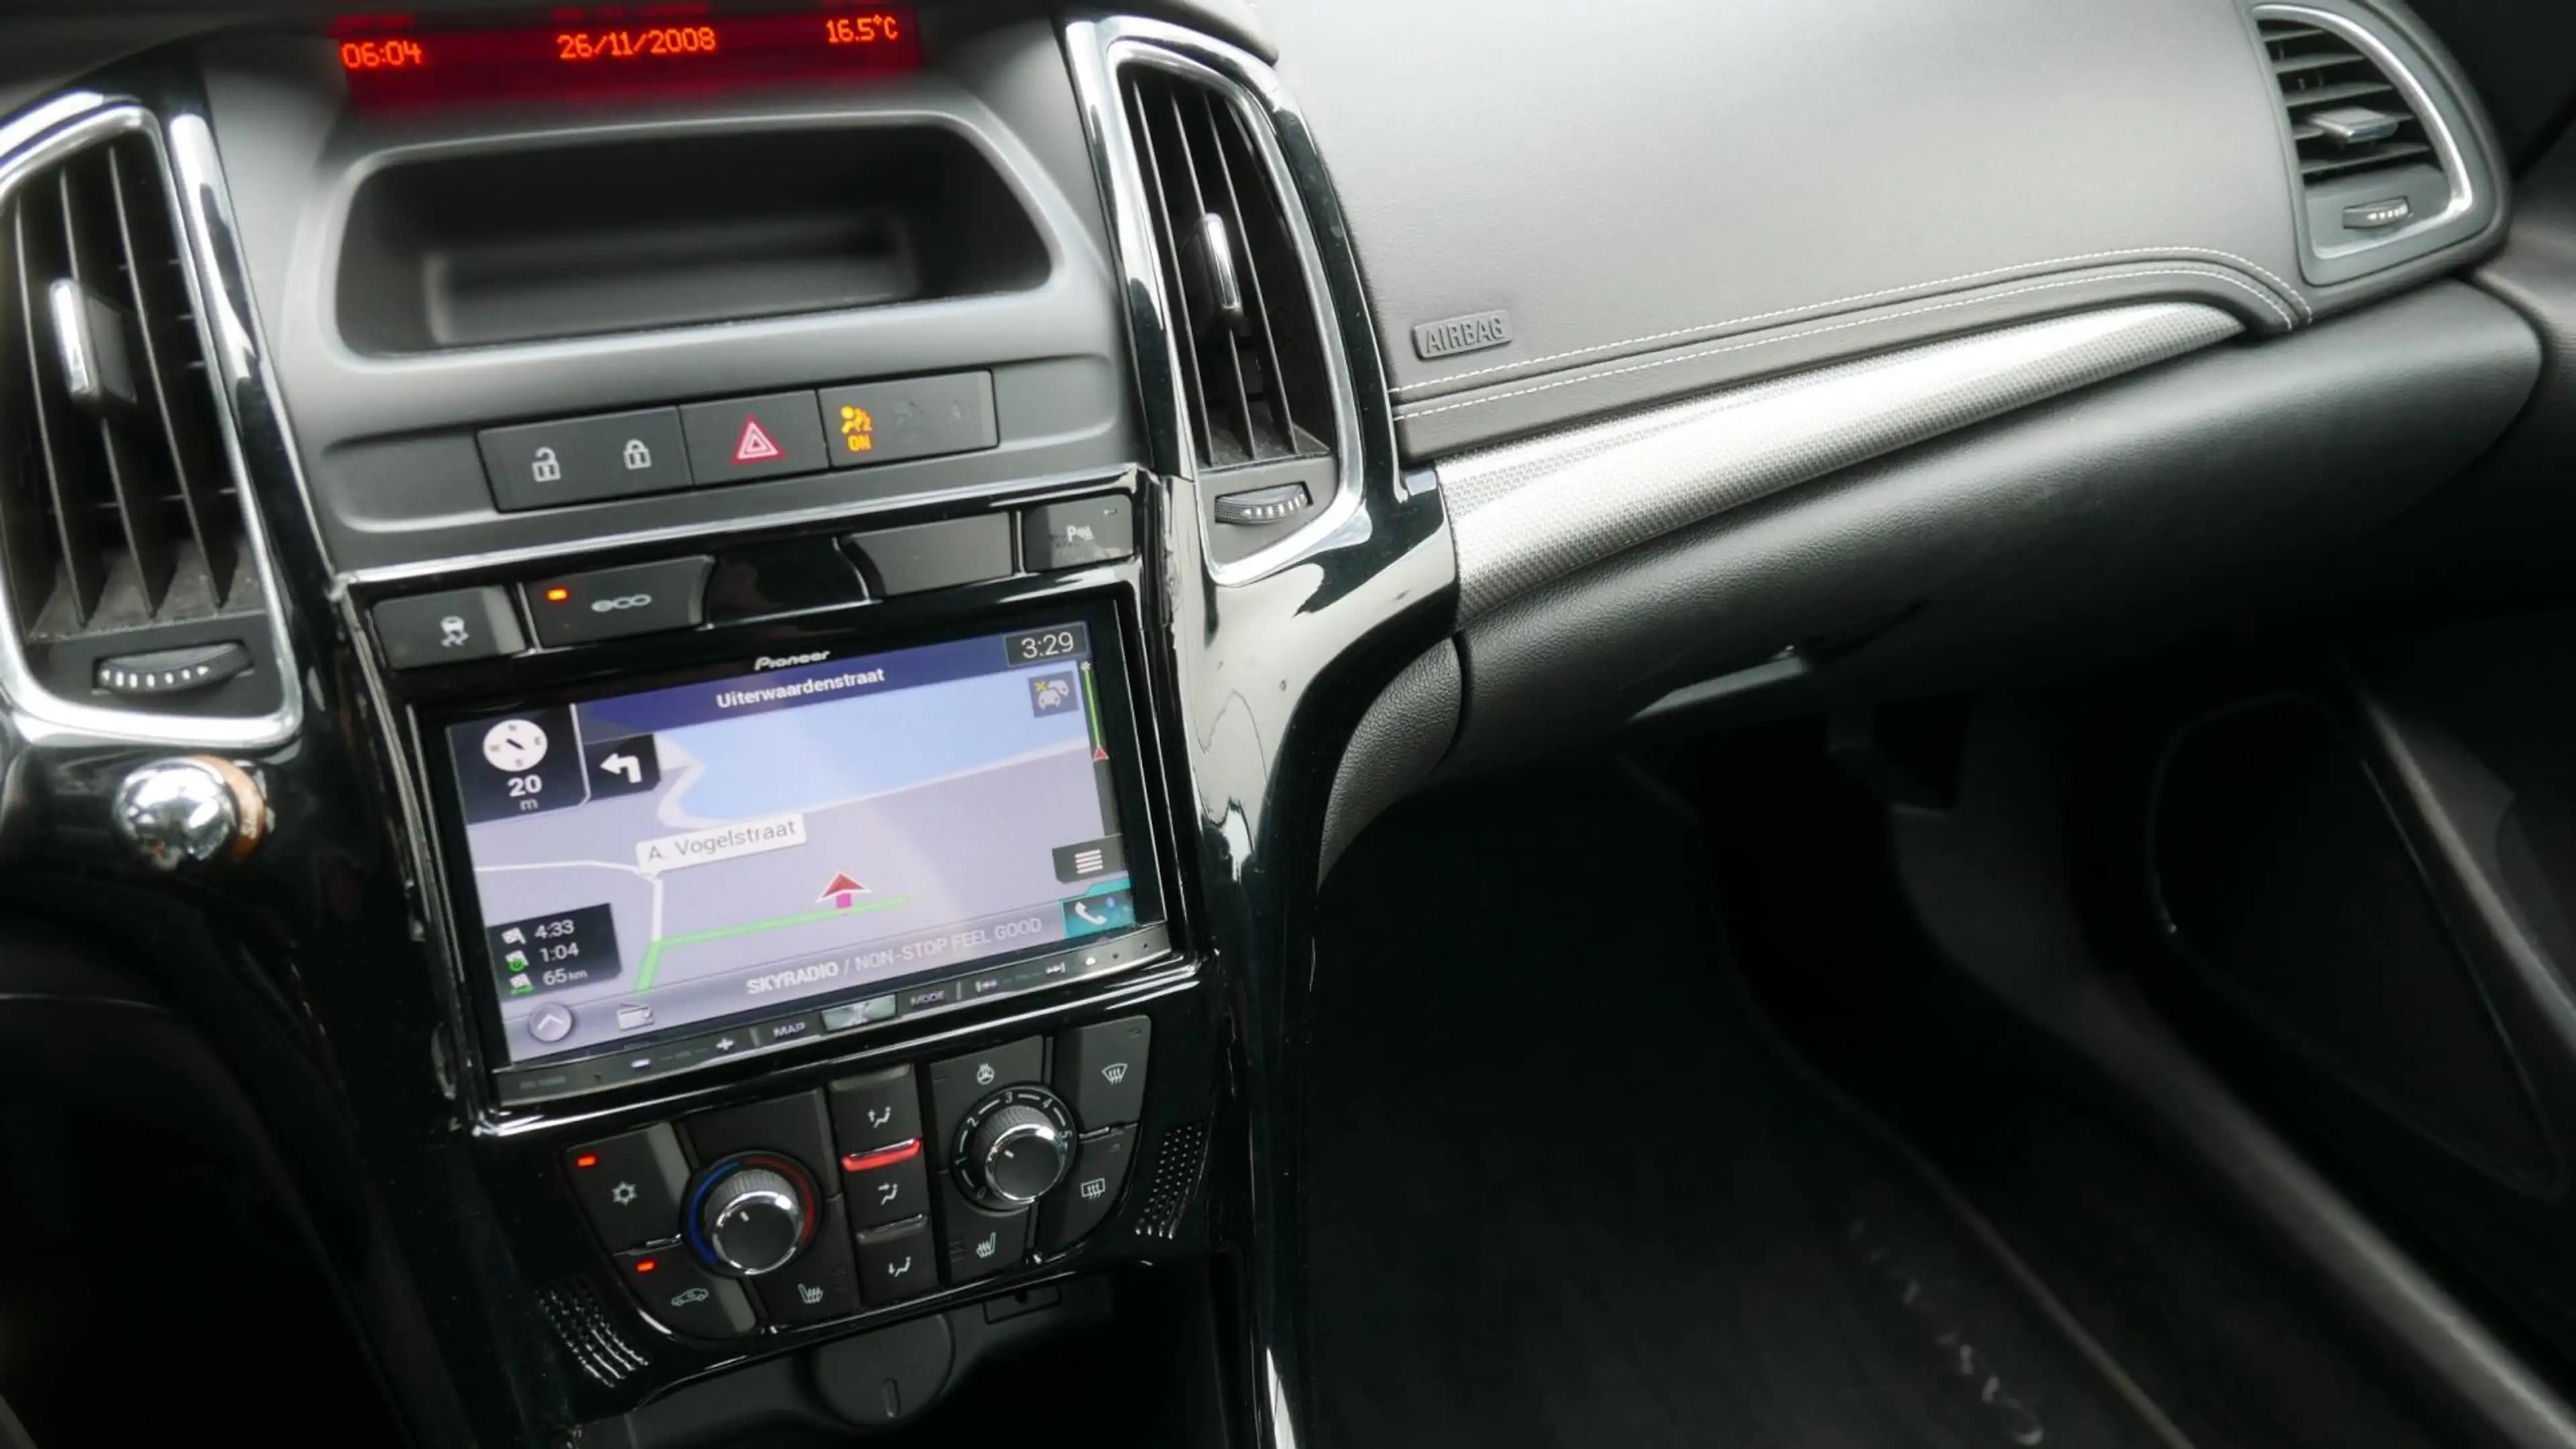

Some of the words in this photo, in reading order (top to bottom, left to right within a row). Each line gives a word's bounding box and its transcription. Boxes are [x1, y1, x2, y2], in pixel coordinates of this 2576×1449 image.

[826, 13, 899, 44] 16.5°C
[557, 26, 716, 59] 26/11/2008
[342, 40, 422, 68] 06:04
[1425, 317, 1504, 354] AIRBAG
[847, 434, 871, 451] ON
[1022, 632, 1074, 659] 3:29
[754, 651, 830, 671] Pioneer
[716, 667, 885, 708] Uiterwaardenstraat
[507, 774, 543, 797] 20
[520, 799, 539, 810] m
[674, 820, 796, 855] Vogelstraat
[534, 918, 575, 938] 4:33
[539, 942, 580, 963] 1:04
[745, 961, 839, 995] SKYRADIO
[855, 937, 947, 971] NON-STOP
[951, 929, 991, 951] FEEL
[994, 918, 1042, 940] GOOD
[910, 990, 945, 1006] MODE
[773, 1022, 805, 1038] MAP
[1004, 1092, 1014, 1104] 3
[1042, 1098, 1053, 1108] 4
[967, 1116, 979, 1128] 2
[1059, 1130, 1073, 1139] 5
